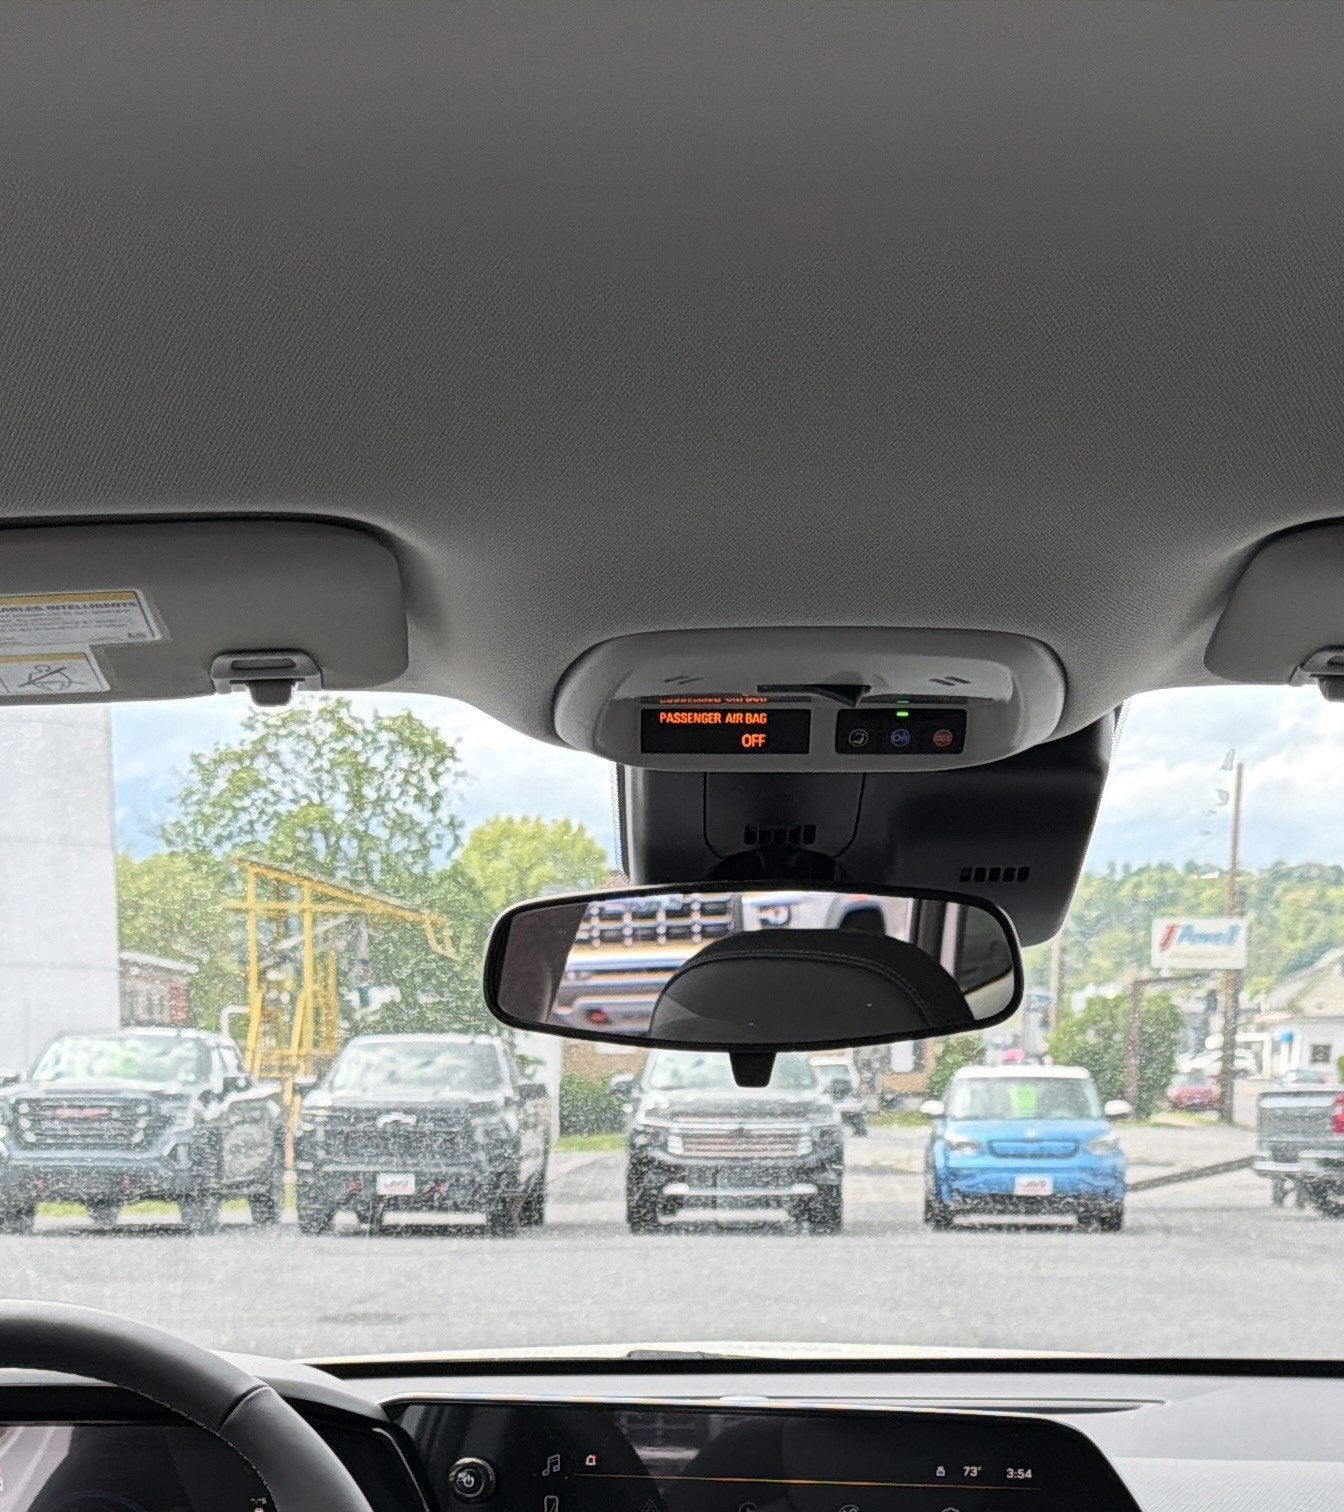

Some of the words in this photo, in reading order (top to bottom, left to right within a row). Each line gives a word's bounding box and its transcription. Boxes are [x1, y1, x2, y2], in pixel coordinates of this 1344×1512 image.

[659, 712, 722, 725] PASSENGER
[724, 712, 744, 724] AIR
[745, 712, 768, 725] BAG
[741, 733, 767, 748] OFF
[963, 1466, 983, 1478] 73°
[1006, 1468, 1033, 1480] 3:54
